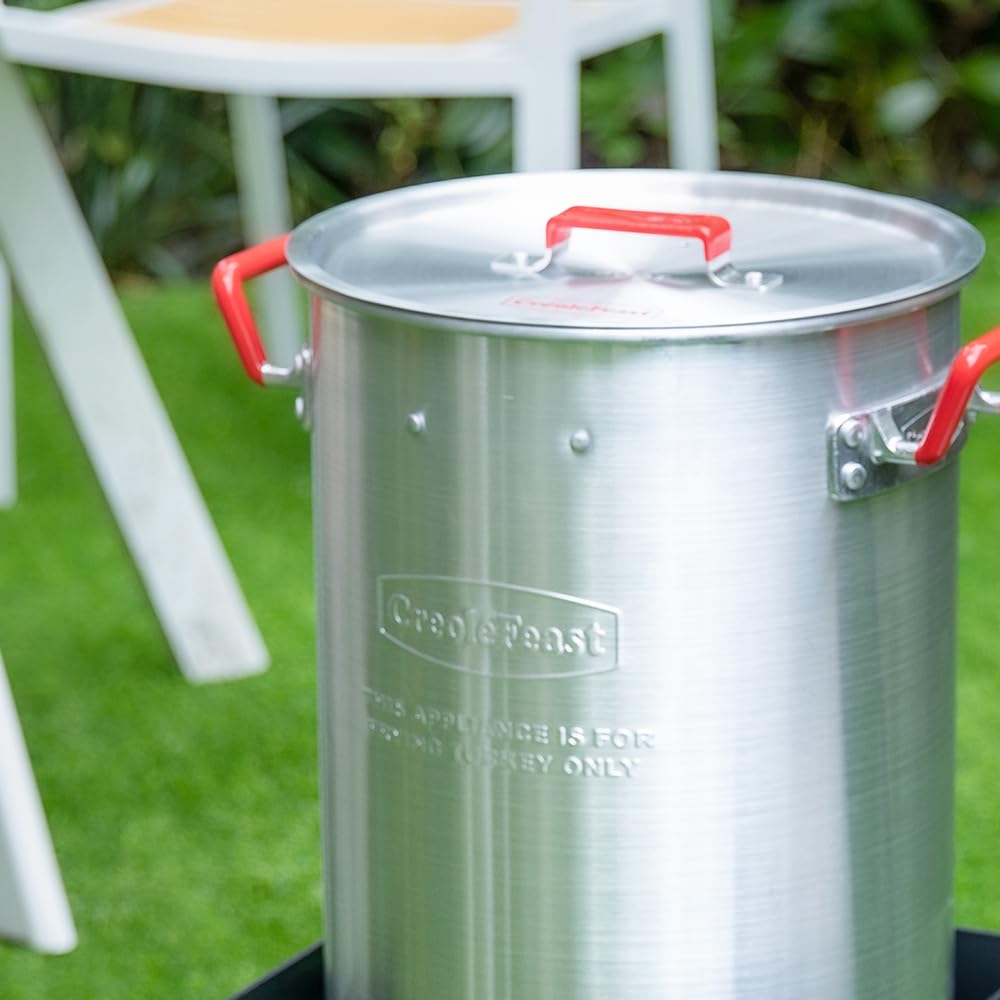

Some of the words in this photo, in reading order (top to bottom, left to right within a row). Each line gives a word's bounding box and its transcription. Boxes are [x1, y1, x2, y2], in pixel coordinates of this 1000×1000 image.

[387, 592, 607, 657] CreoleFeast
[559, 725, 586, 747] IS
[593, 726, 656, 749] FOR
[563, 754, 641, 777] ONLY
